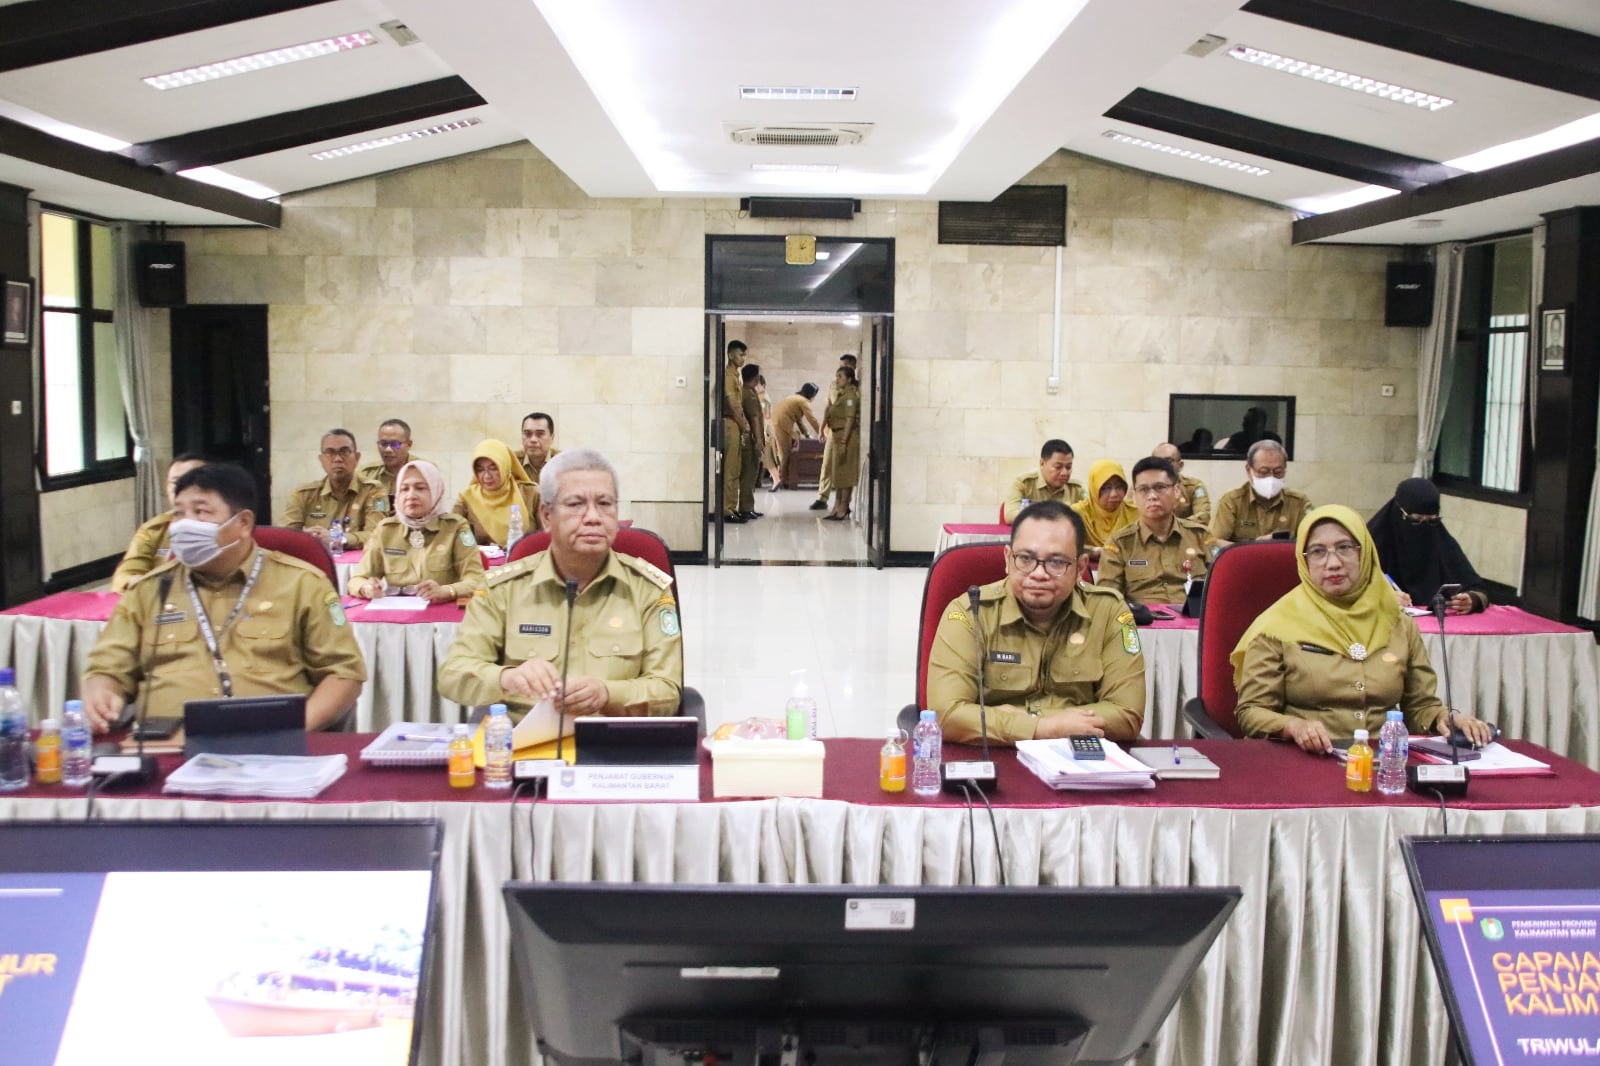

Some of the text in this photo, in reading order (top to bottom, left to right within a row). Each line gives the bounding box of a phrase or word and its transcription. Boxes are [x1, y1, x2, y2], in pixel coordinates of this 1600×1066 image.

[630, 772, 675, 780] GUBERNUR
[1514, 928, 1596, 938] KALIMANTAN BARAT
[1498, 972, 1600, 994] PENJA
[1504, 993, 1600, 1015] KALIM
